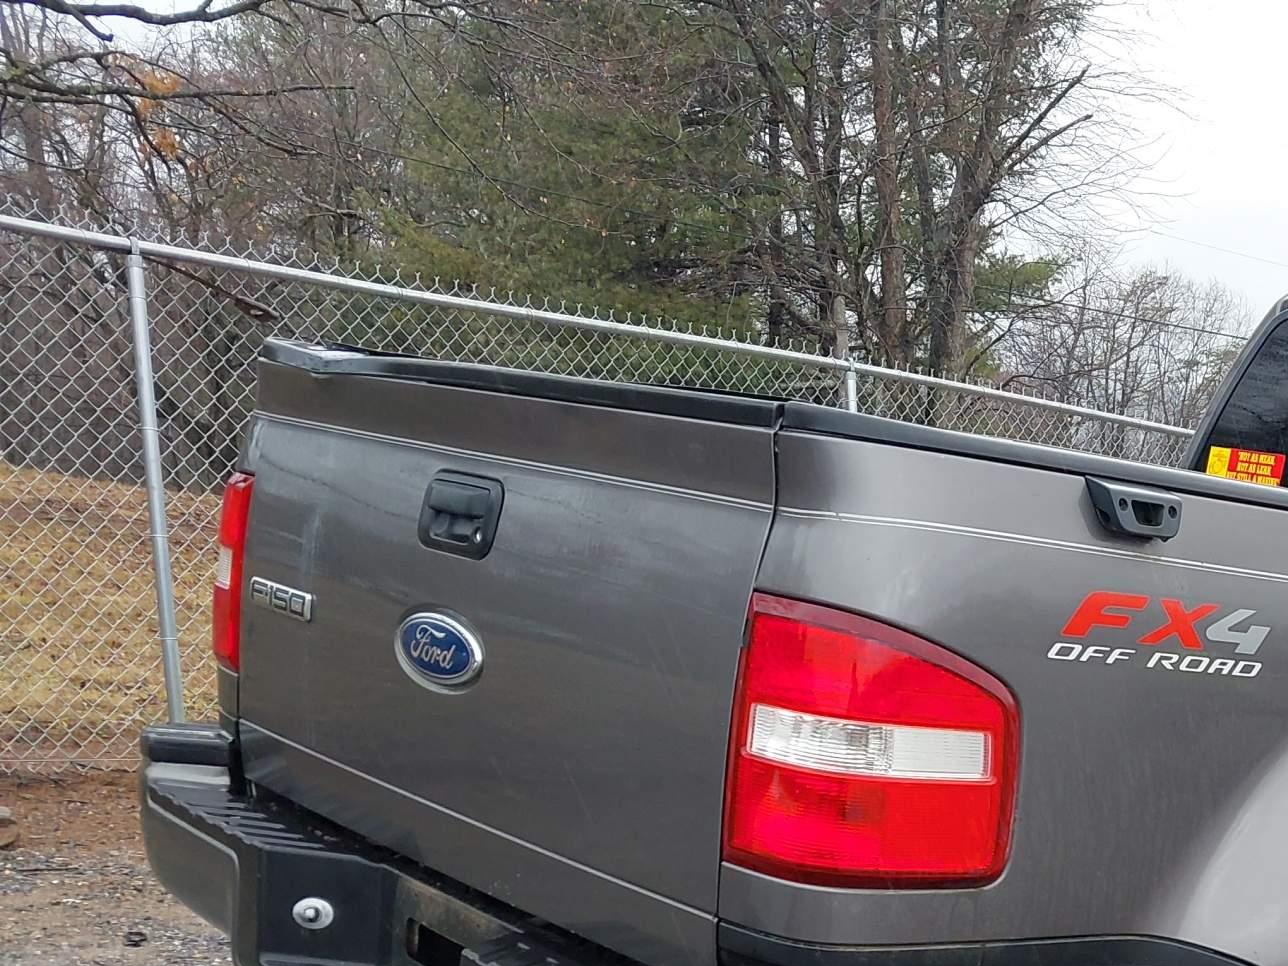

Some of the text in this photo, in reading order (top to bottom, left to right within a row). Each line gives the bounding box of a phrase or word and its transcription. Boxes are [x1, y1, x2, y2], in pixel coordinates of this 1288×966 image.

[1060, 590, 1271, 655] FX4
[411, 624, 456, 669] Ford
[1047, 642, 1262, 677] OFF ROAD
